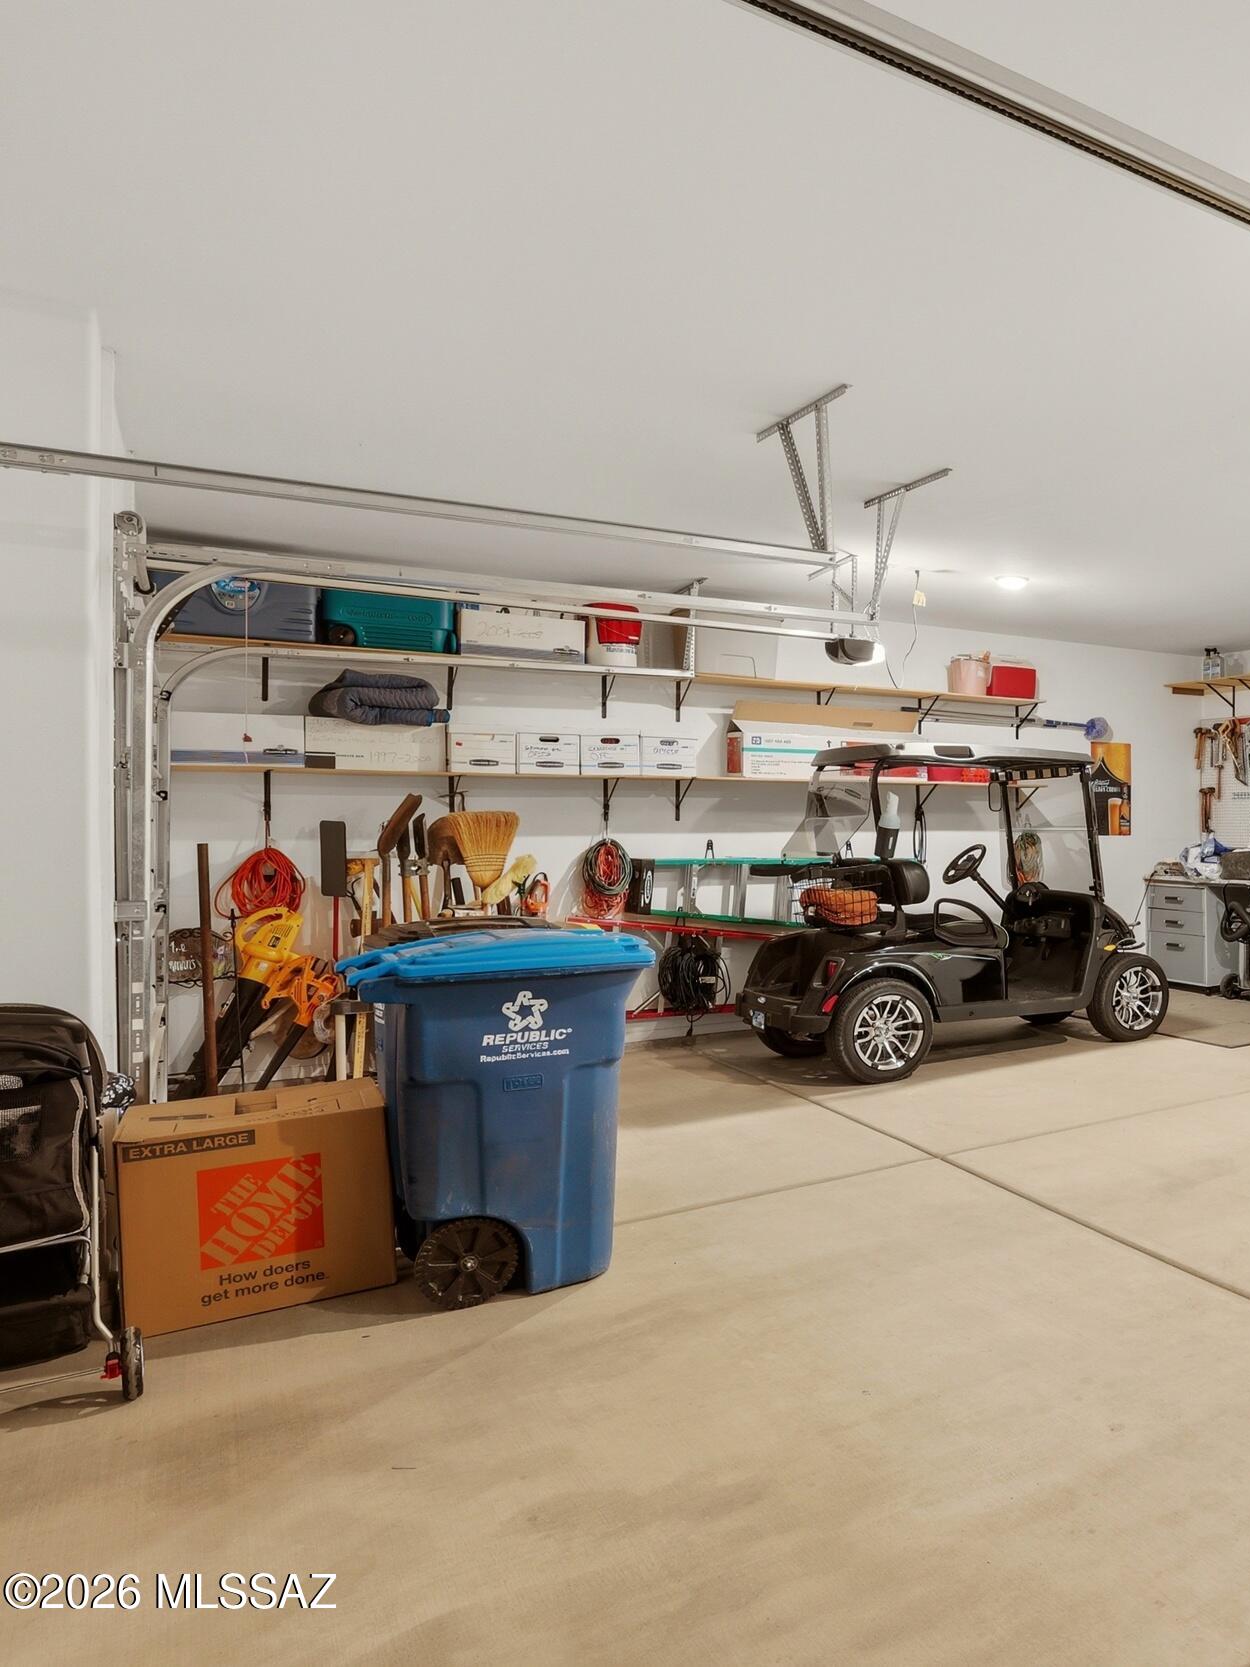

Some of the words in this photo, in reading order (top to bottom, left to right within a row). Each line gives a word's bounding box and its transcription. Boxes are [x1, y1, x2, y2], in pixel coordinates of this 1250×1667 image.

[482, 1028, 567, 1046] REPUBLIC
[502, 1041, 549, 1053] SERVICES
[480, 1048, 570, 1063] RepublicServices.com
[129, 1142, 188, 1160] EXTRA
[192, 1133, 249, 1151] LARGE
[210, 1173, 262, 1217] THE
[200, 1156, 323, 1266] HOME
[250, 1189, 323, 1259] DEPOT
[218, 1271, 258, 1287] How
[263, 1259, 311, 1279] doers
[200, 1290, 230, 1307] get
[235, 1282, 279, 1298] more
[284, 1270, 329, 1289] done.
